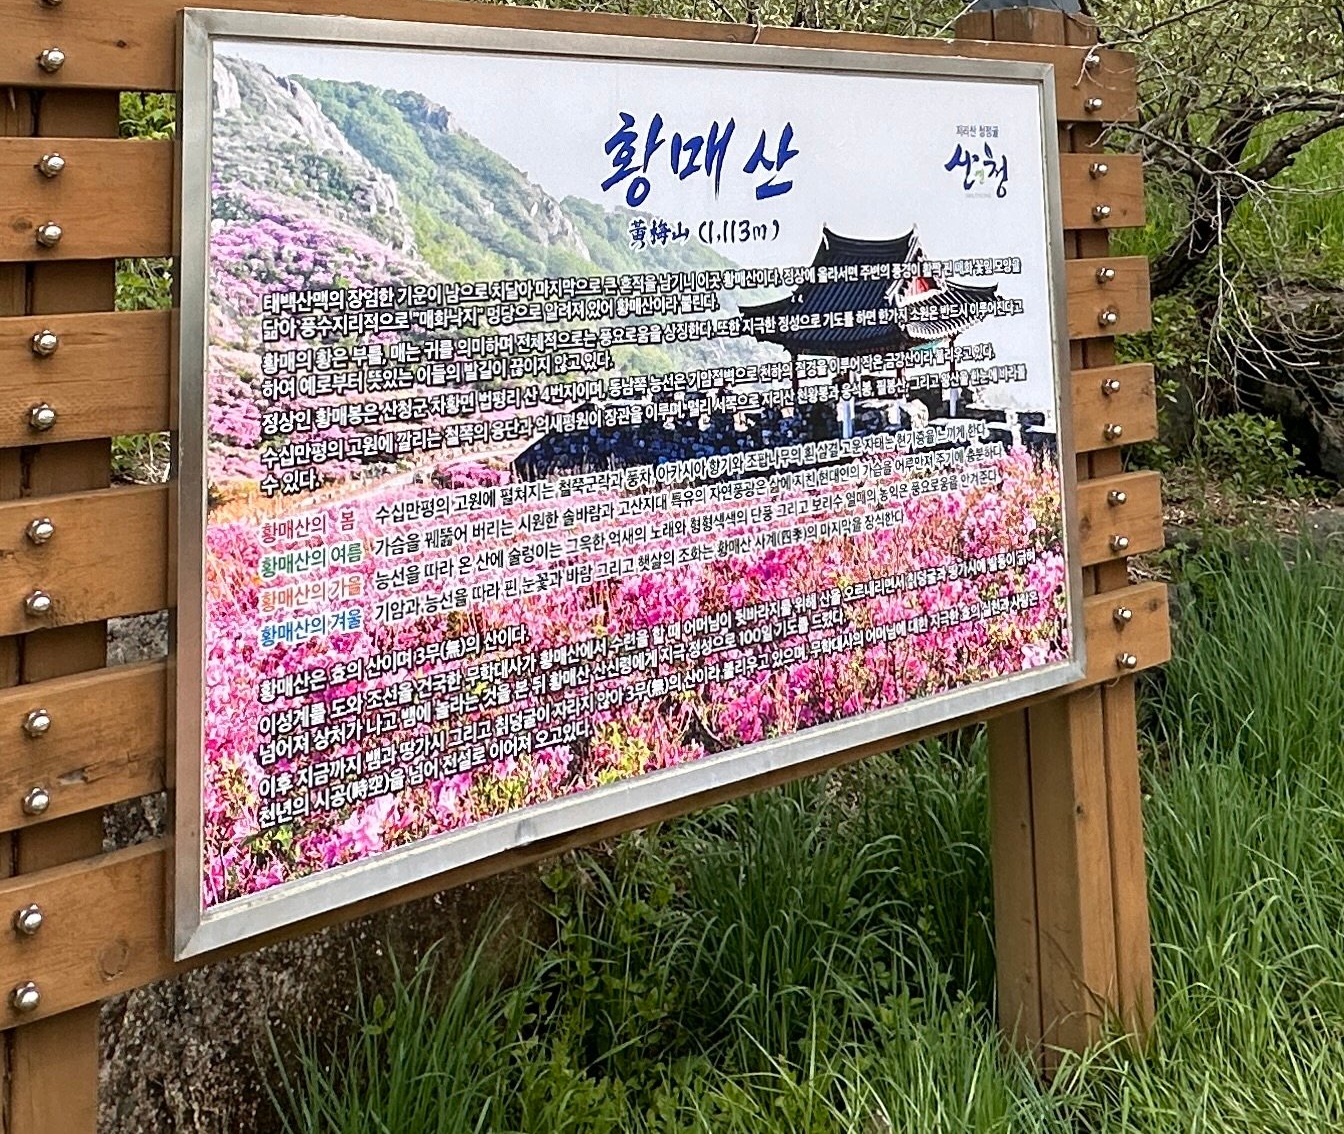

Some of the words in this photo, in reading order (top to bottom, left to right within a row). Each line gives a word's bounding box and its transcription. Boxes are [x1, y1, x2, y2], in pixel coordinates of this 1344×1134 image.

[600, 111, 799, 207] 황매산
[955, 124, 977, 138] 지리산
[261, 289, 345, 314] 태백산맥의
[346, 286, 394, 309] 장엄한
[397, 284, 442, 306] 기운이
[445, 282, 489, 304] 남으로
[490, 280, 534, 301] 치달아
[535, 277, 602, 299] 마지막으로
[659, 272, 695, 292] 남기니
[696, 271, 721, 290] 이곳
[723, 268, 781, 288] 황매산이다.
[782, 266, 815, 285] 정상에
[817, 264, 858, 283] 올라서면
[262, 317, 296, 341] 닮아
[299, 310, 410, 338] 풍수지리적으로
[544, 300, 585, 322] 알려져
[586, 298, 613, 319] 있어
[616, 295, 677, 317] 황매산이라
[680, 292, 720, 313] 불린다.
[261, 349, 312, 375] 황매의
[314, 346, 349, 371] 황은
[351, 344, 387, 368] 부를,
[390, 341, 421, 365] 매는
[424, 339, 454, 362] 귀를
[457, 335, 513, 359] 의미하며
[516, 328, 597, 354] 전체적으로는
[598, 324, 662, 348] 풍요로움을
[663, 320, 715, 343] 상징한다.
[741, 316, 776, 336] 지극한
[778, 312, 822, 333] 정성으로
[822, 310, 854, 330] 기도를
[261, 376, 294, 400] 하여
[298, 370, 363, 397] 예로부터
[416, 362, 460, 386] 이들의
[463, 358, 506, 382] 발길이
[509, 354, 550, 378] 끊이지
[261, 408, 310, 435] 정상인
[314, 401, 378, 429] 황매봉은
[381, 396, 429, 422] 산청군
[431, 392, 474, 417] 차황면
[478, 388, 520, 412] 법평리
[540, 379, 605, 405] 4번지이며,
[608, 375, 646, 398] 동남쪽
[649, 371, 685, 393] 능선은
[688, 364, 758, 389] 기암절벽으로
[759, 361, 793, 382] 천하의
[794, 358, 828, 378] 절경을
[829, 355, 860, 375] 이루어
[261, 438, 343, 469] 수십만평의
[346, 433, 394, 459] 고원에
[397, 427, 441, 453] 깔리는
[491, 417, 533, 441] 융단과
[535, 409, 601, 436] 억새평원이
[604, 405, 643, 428] 장관을
[687, 397, 711, 418] 멀리
[714, 392, 760, 415] 서쪽으로
[761, 388, 795, 410] 지리산
[282, 467, 321, 493] 있다.
[375, 495, 450, 526] 수십만평의
[454, 488, 496, 514] 고원에
[499, 479, 558, 507] 펼쳐지는
[558, 470, 623, 498] 철쭉군락과
[656, 459, 705, 484] 아카시아
[707, 454, 743, 476] 향기와
[375, 531, 420, 558] 가슴을
[472, 516, 514, 542] 버리는
[518, 509, 559, 534] 시원한
[561, 501, 615, 527] 솔바람과
[617, 493, 666, 518] 고산지대
[670, 487, 705, 510] 특유의
[709, 477, 769, 503] 자연풍광은
[818, 463, 860, 486] 현대인의
[862, 458, 892, 479] 가슴을
[260, 546, 326, 578] 황매산의
[330, 540, 361, 566] 여름
[261, 513, 326, 544] 황매산의
[375, 563, 420, 591] 능선을
[424, 557, 454, 582] 따라
[476, 549, 503, 573] 산에
[507, 539, 562, 567] 술렁이는
[608, 525, 646, 549] 억새의
[649, 518, 686, 542] 노래와
[690, 508, 747, 535] 형형색색의
[775, 498, 809, 520] 그리고
[811, 492, 843, 514] 보리수
[846, 487, 876, 508] 열매의
[260, 579, 326, 613] 황매산의
[330, 573, 361, 600] 가을
[375, 595, 420, 624] 기암과
[424, 586, 468, 615] 능선을
[472, 580, 500, 605] 따라
[521, 569, 562, 595] 눈꽃과
[566, 563, 592, 587] 바람
[598, 556, 634, 580] 그리고
[637, 548, 674, 573] 햇살의
[677, 541, 714, 565] 조화는
[717, 535, 751, 558] 황매산
[819, 515, 862, 539] 마지막을
[259, 666, 327, 704] 황매산은
[329, 658, 361, 688] 효의
[366, 647, 411, 680] 산이며
[484, 622, 529, 653] 산이다.
[260, 613, 326, 648] 황매산의
[330, 606, 361, 634] 겨울
[259, 700, 325, 738] 이성계를
[330, 691, 362, 722] 도와
[366, 680, 413, 713] 조선을
[417, 669, 462, 701] 건국한
[466, 653, 535, 689] 무학대사가
[540, 637, 606, 672] 황매산에서
[610, 628, 648, 655] 수련을
[684, 610, 731, 639] 어머님이
[259, 731, 309, 766] 넘어져
[313, 718, 362, 752] 상처가
[366, 710, 397, 739] 나고
[401, 702, 431, 730] 뱀에
[435, 690, 479, 722] 놀라는
[483, 683, 510, 709] 것을
[548, 664, 590, 693] 황매산
[593, 649, 657, 682] 산신령에게
[660, 642, 686, 666] 지극
[688, 631, 737, 660] 정성으로
[259, 768, 292, 800] 이후
[296, 751, 361, 790] 지금까지
[365, 743, 395, 772] 뱀과
[399, 731, 444, 763] 땅가시
[447, 719, 492, 750] 그리고
[552, 693, 594, 722] 자라지
[597, 686, 623, 711] 않아
[684, 663, 720, 689] 산이라
[258, 792, 308, 830] 천년의
[408, 758, 435, 788] 넘어
[442, 745, 486, 778] 전설로
[489, 733, 531, 765] 이어져
